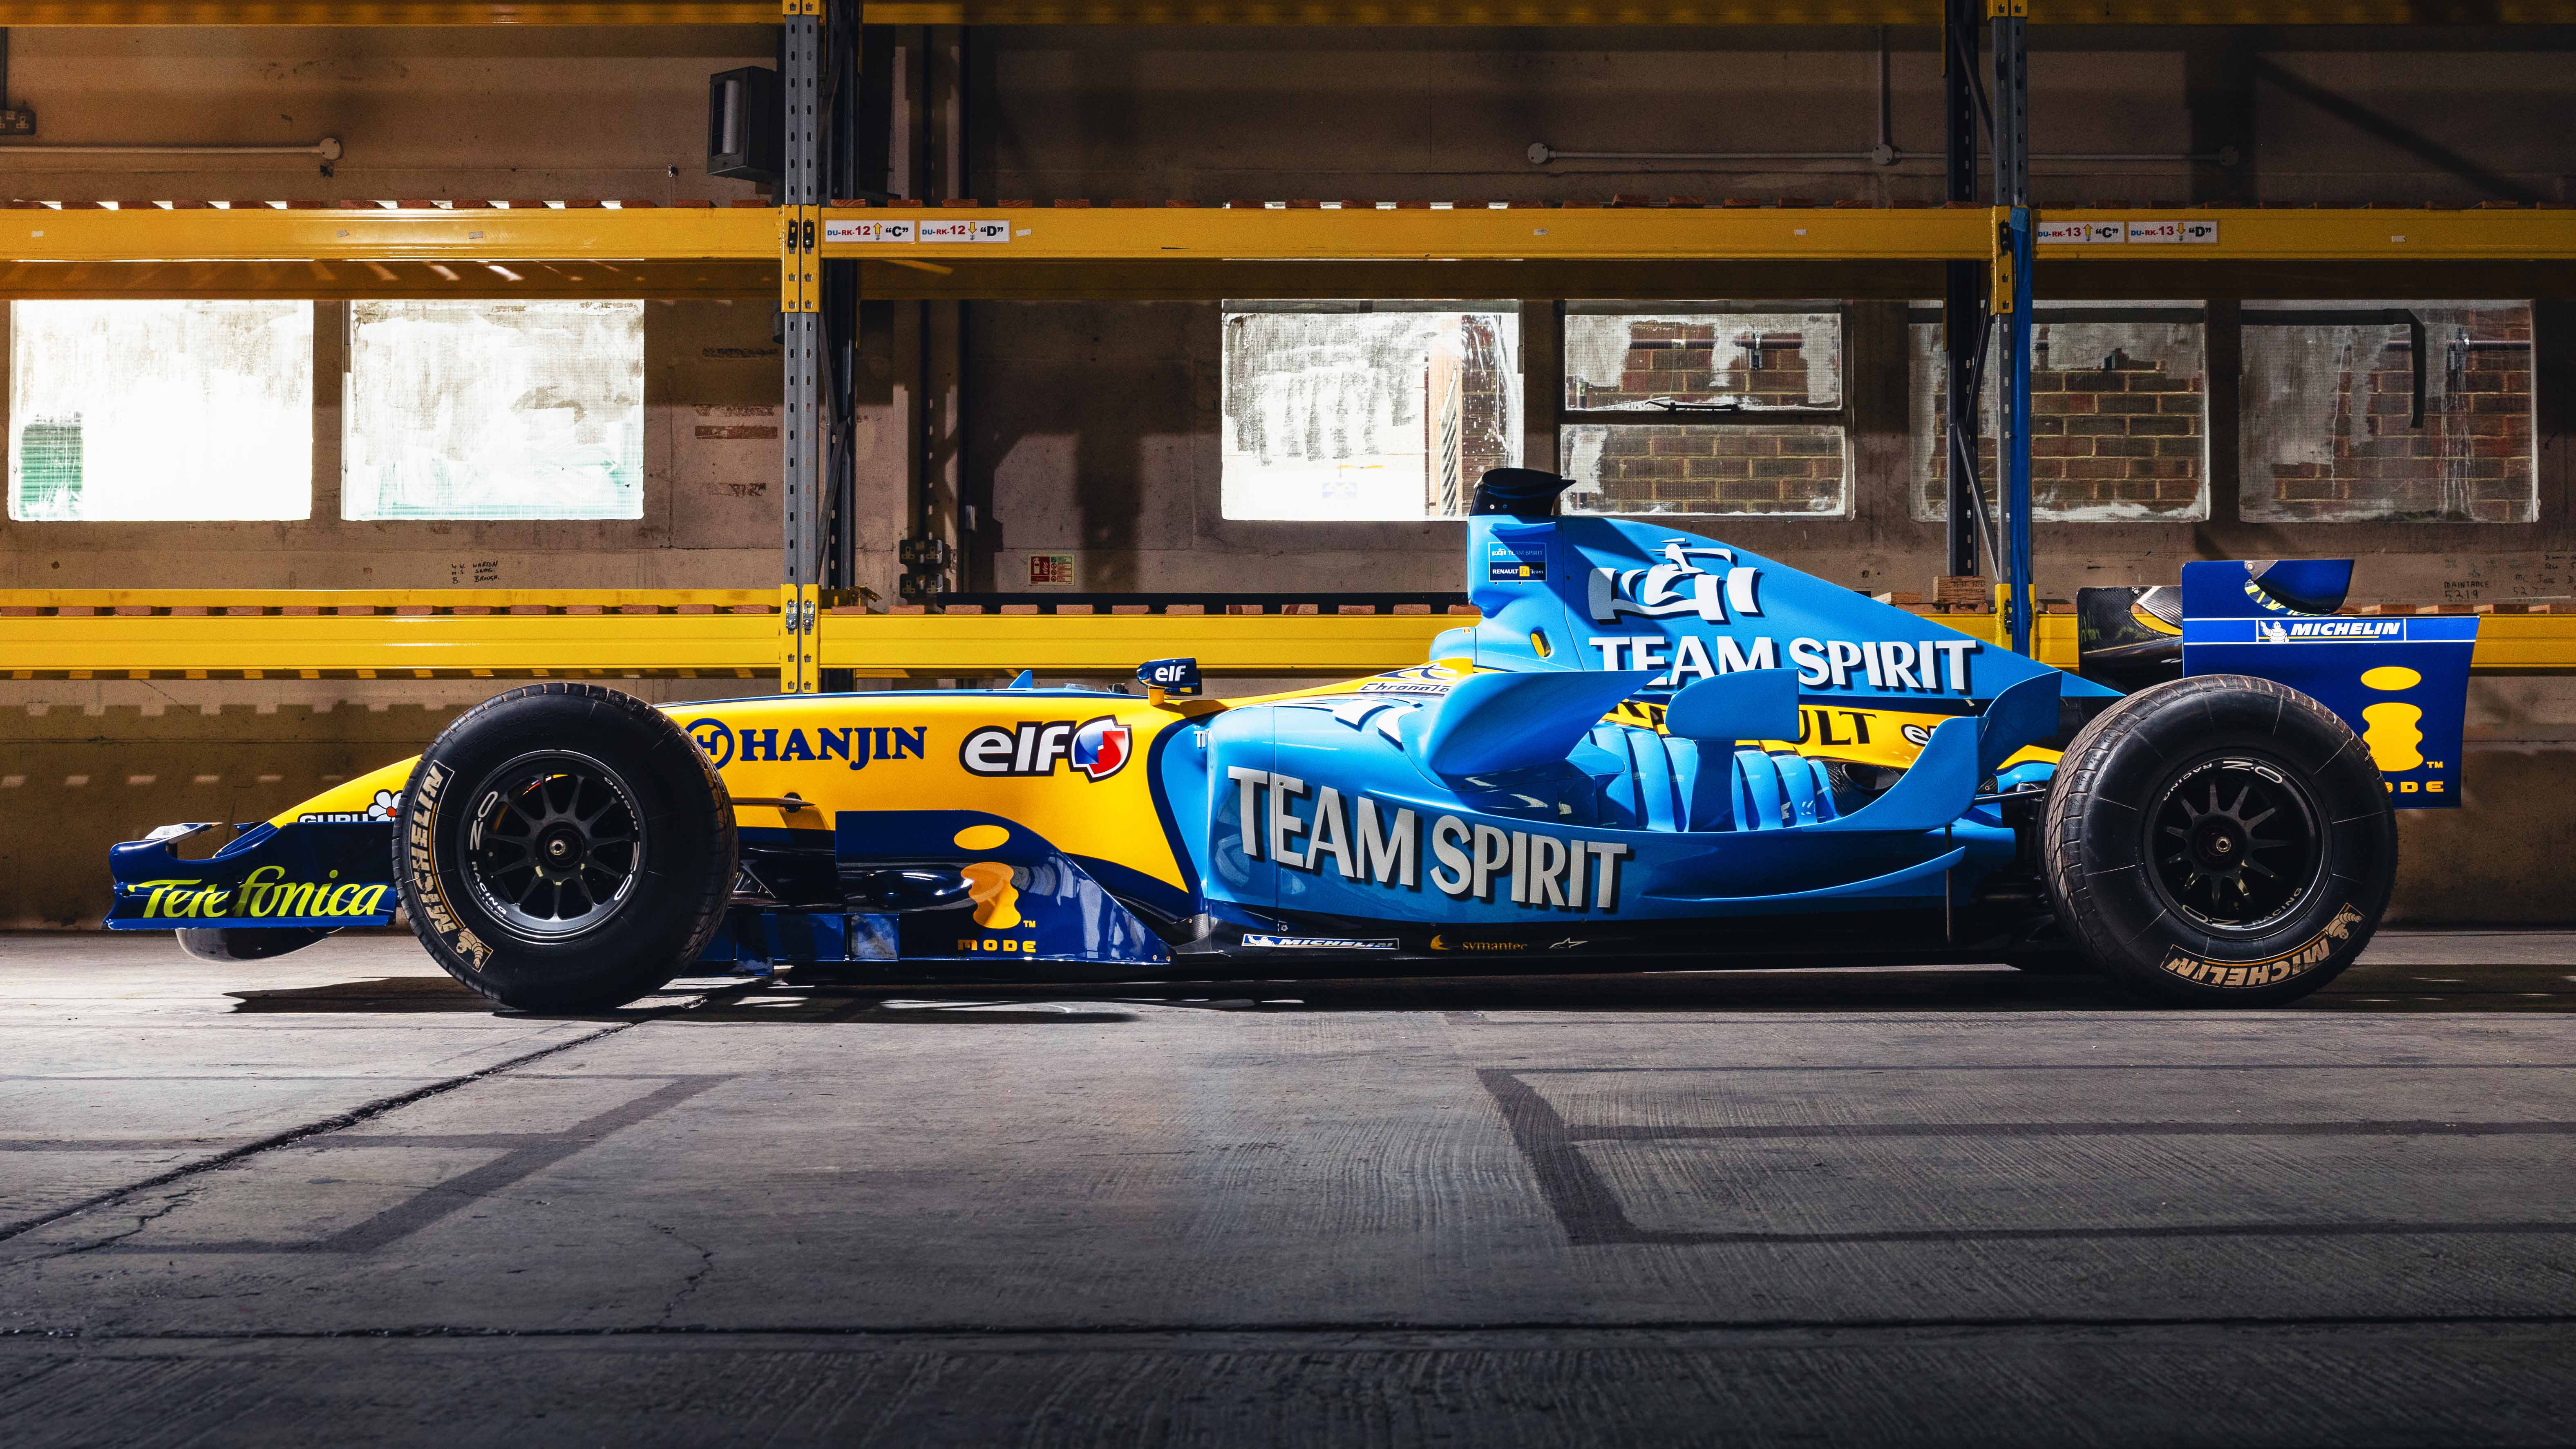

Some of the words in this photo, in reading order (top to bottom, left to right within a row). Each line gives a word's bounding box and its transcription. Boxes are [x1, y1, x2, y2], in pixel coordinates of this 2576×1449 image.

[2445, 589, 2478, 600] 5219
[2290, 621, 2401, 636] MICHELIN
[1155, 665, 1186, 682] elf
[1588, 636, 1775, 685] TEAM
[1789, 637, 1977, 690] SPIRIT
[740, 726, 928, 770] HANJIN
[960, 721, 1076, 777] elf
[410, 766, 458, 934] MICHELIN
[1228, 766, 1417, 886] TEAM
[1430, 815, 1627, 908] SPIRIT
[957, 939, 1036, 953] MODE
[1278, 938, 1393, 948] MICHELIN
[1462, 941, 1528, 950] symantec
[2166, 938, 2330, 986] MICHELIN
